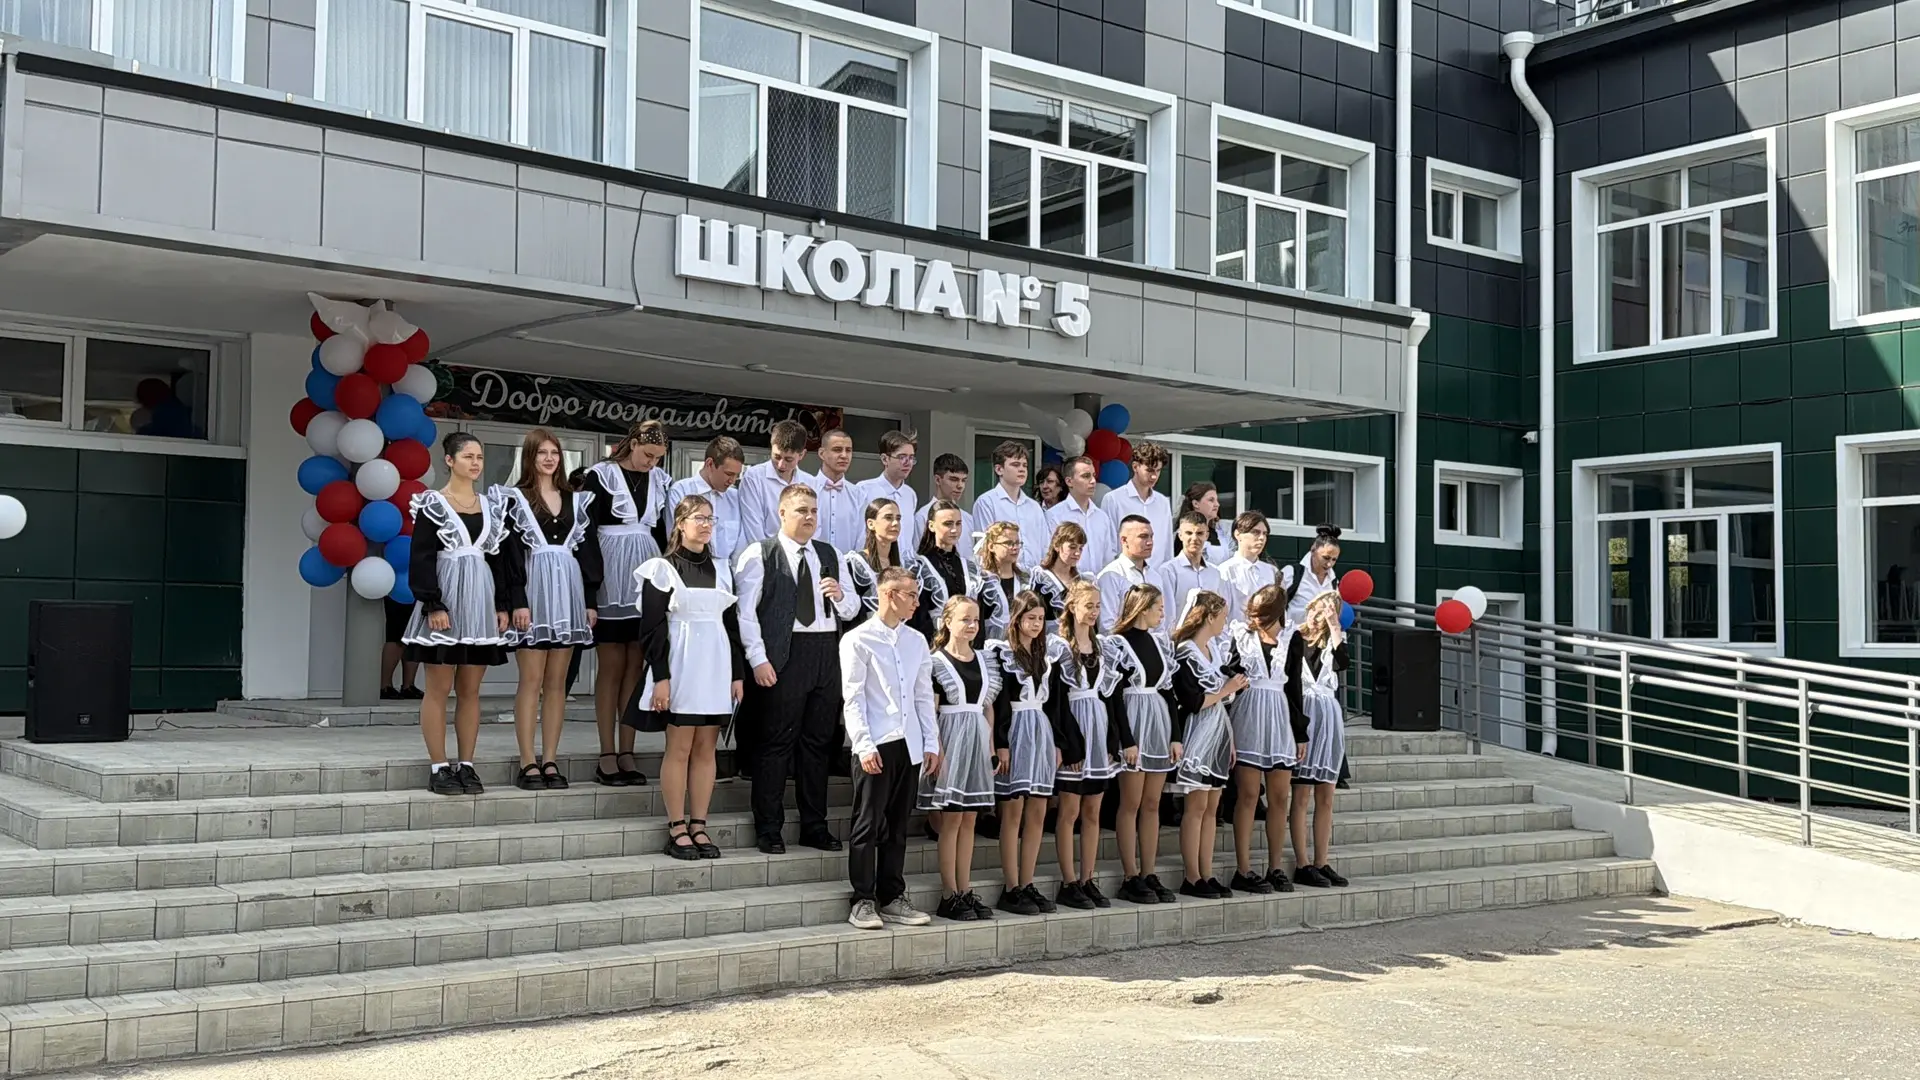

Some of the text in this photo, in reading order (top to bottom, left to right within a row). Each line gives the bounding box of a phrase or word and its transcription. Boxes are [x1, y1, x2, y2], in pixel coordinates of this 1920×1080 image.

[675, 214, 1091, 338] ШКОЛА № 5
[470, 370, 584, 424] Добро
